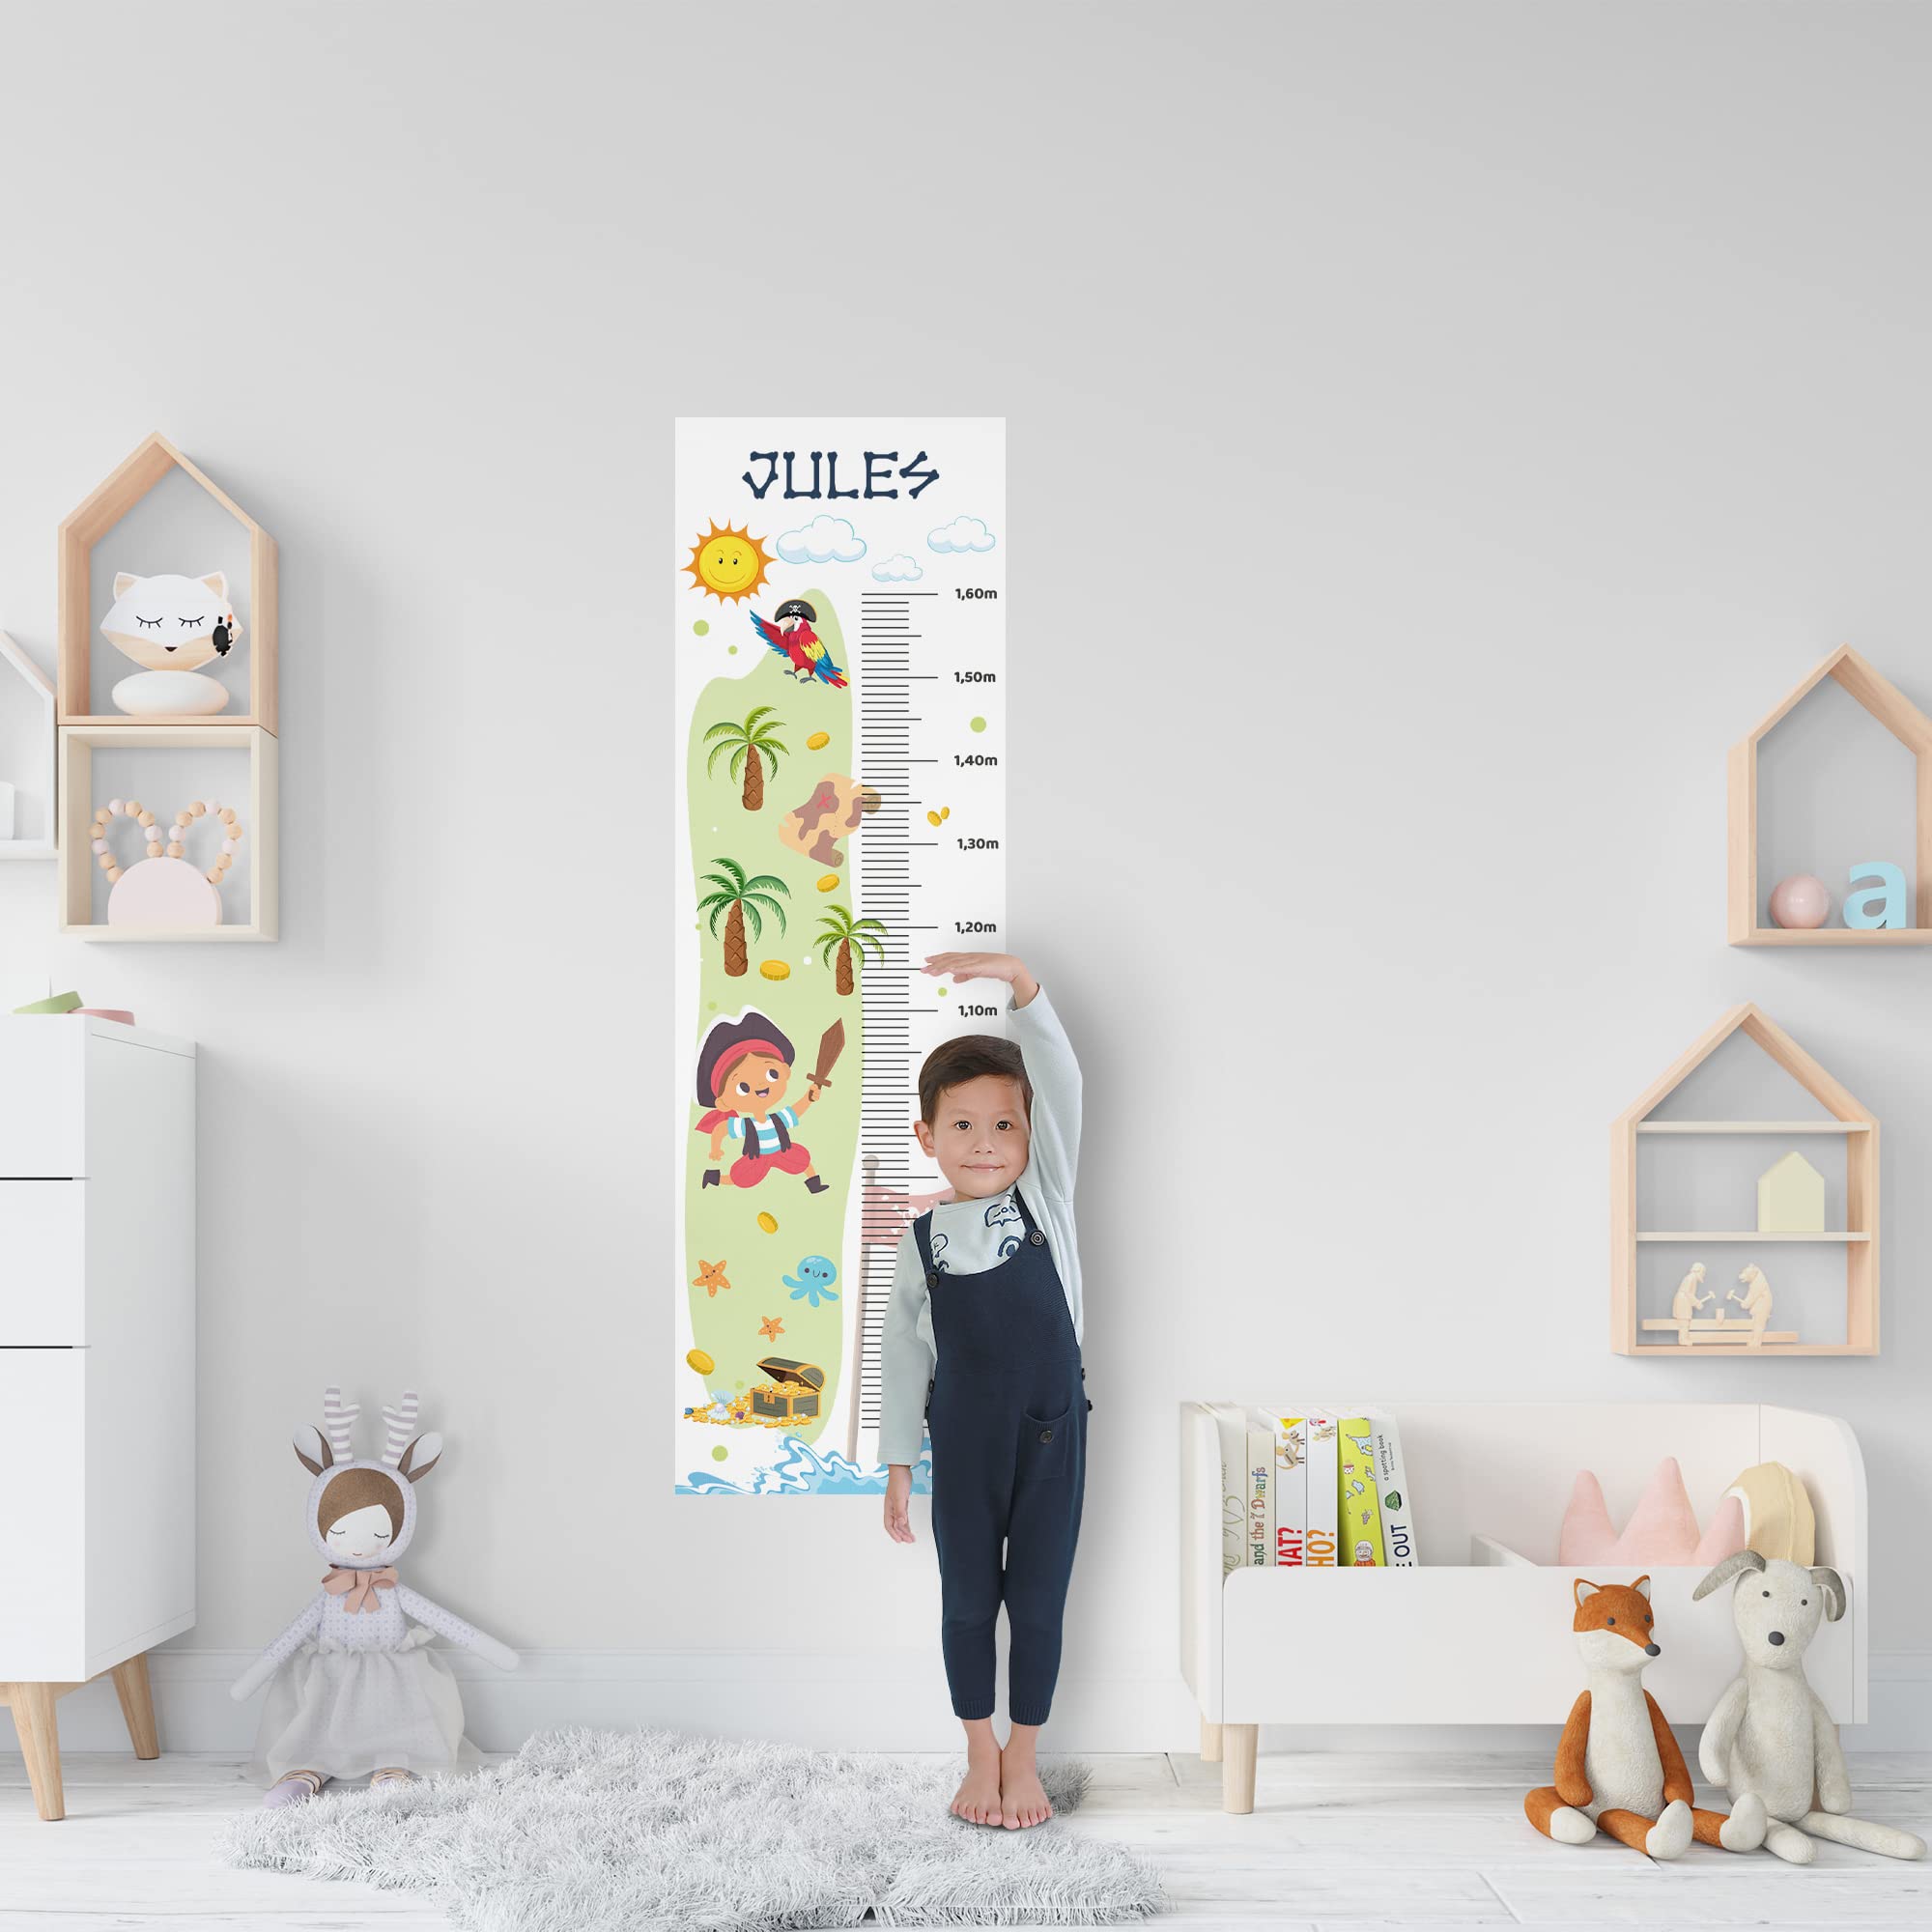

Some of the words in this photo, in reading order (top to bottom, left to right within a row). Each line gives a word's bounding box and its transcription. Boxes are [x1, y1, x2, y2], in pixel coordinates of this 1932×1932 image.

[742, 451, 940, 499] JULES
[954, 587, 998, 601] 1,60m
[953, 671, 996, 685] 1,50m
[953, 754, 998, 768] 1,40m
[956, 838, 999, 851] 1,30m
[954, 921, 997, 934] 1,20m
[957, 1005, 998, 1018] 1,10m
[1377, 1434, 1385, 1450] book
[1379, 1449, 1390, 1476] spotting
[1251, 1466, 1268, 1510] Dwarfs
[1250, 1521, 1264, 1541] the
[1390, 1524, 1410, 1558] OUT
[1250, 1543, 1267, 1566] and
